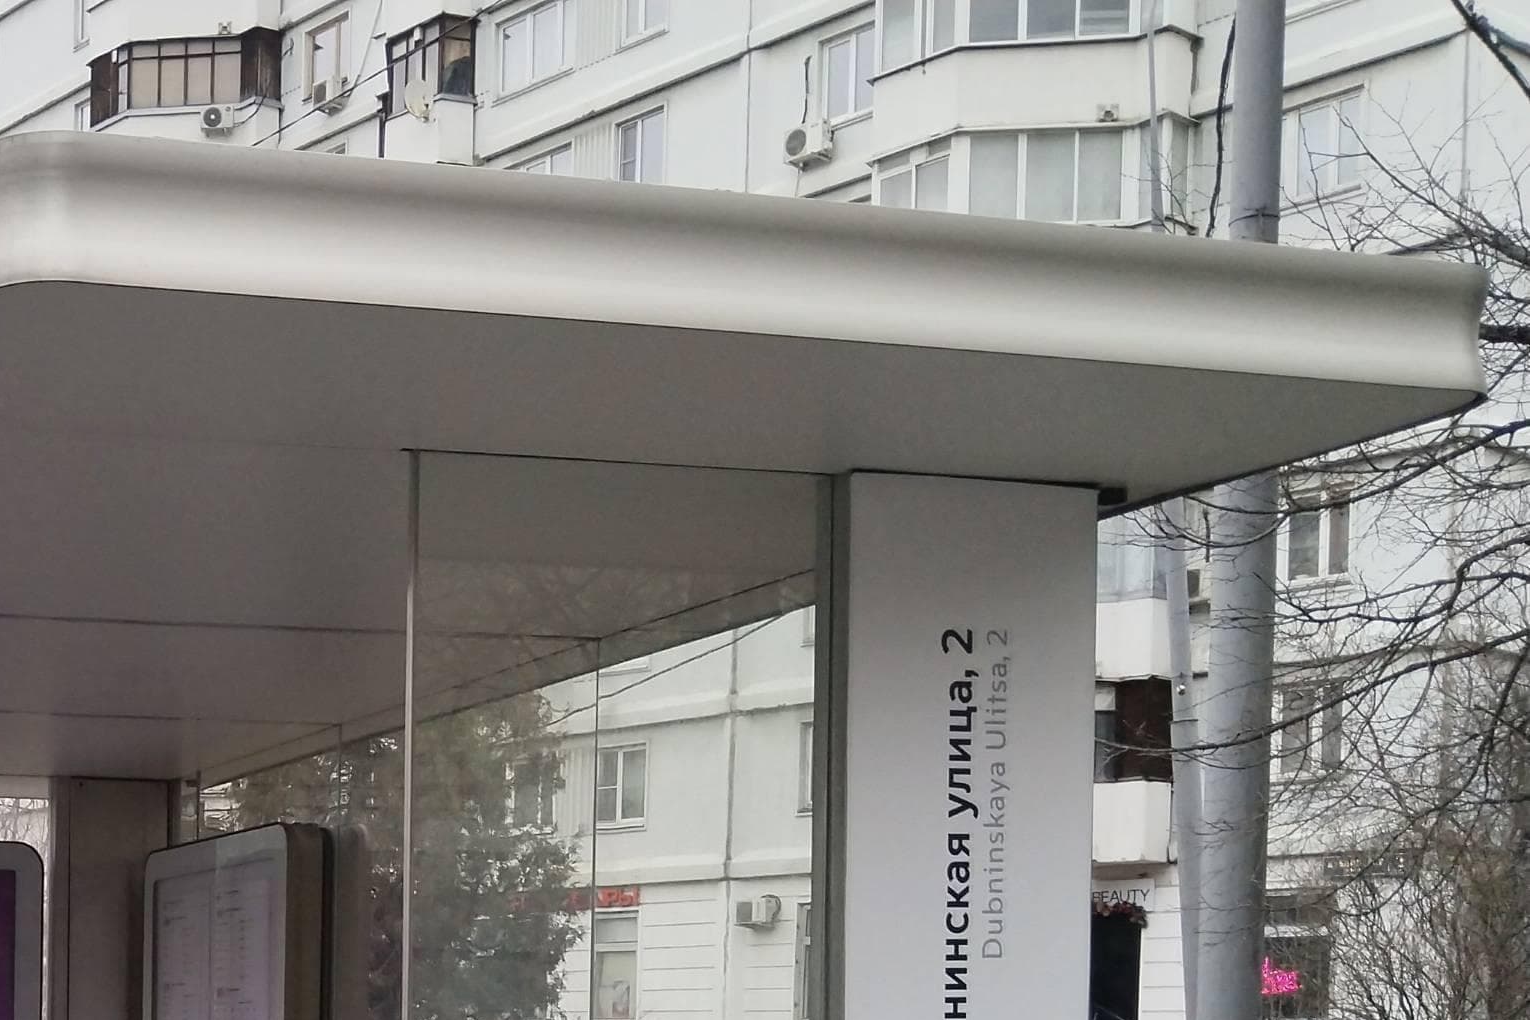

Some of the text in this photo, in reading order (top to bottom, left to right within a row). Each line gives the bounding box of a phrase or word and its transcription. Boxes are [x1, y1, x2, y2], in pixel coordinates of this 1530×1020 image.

[941, 628, 974, 654] 2
[948, 669, 979, 819] улица,
[982, 628, 1012, 959] Dubninskaya Ulitsa, 2
[1092, 889, 1150, 904] BEAUTY
